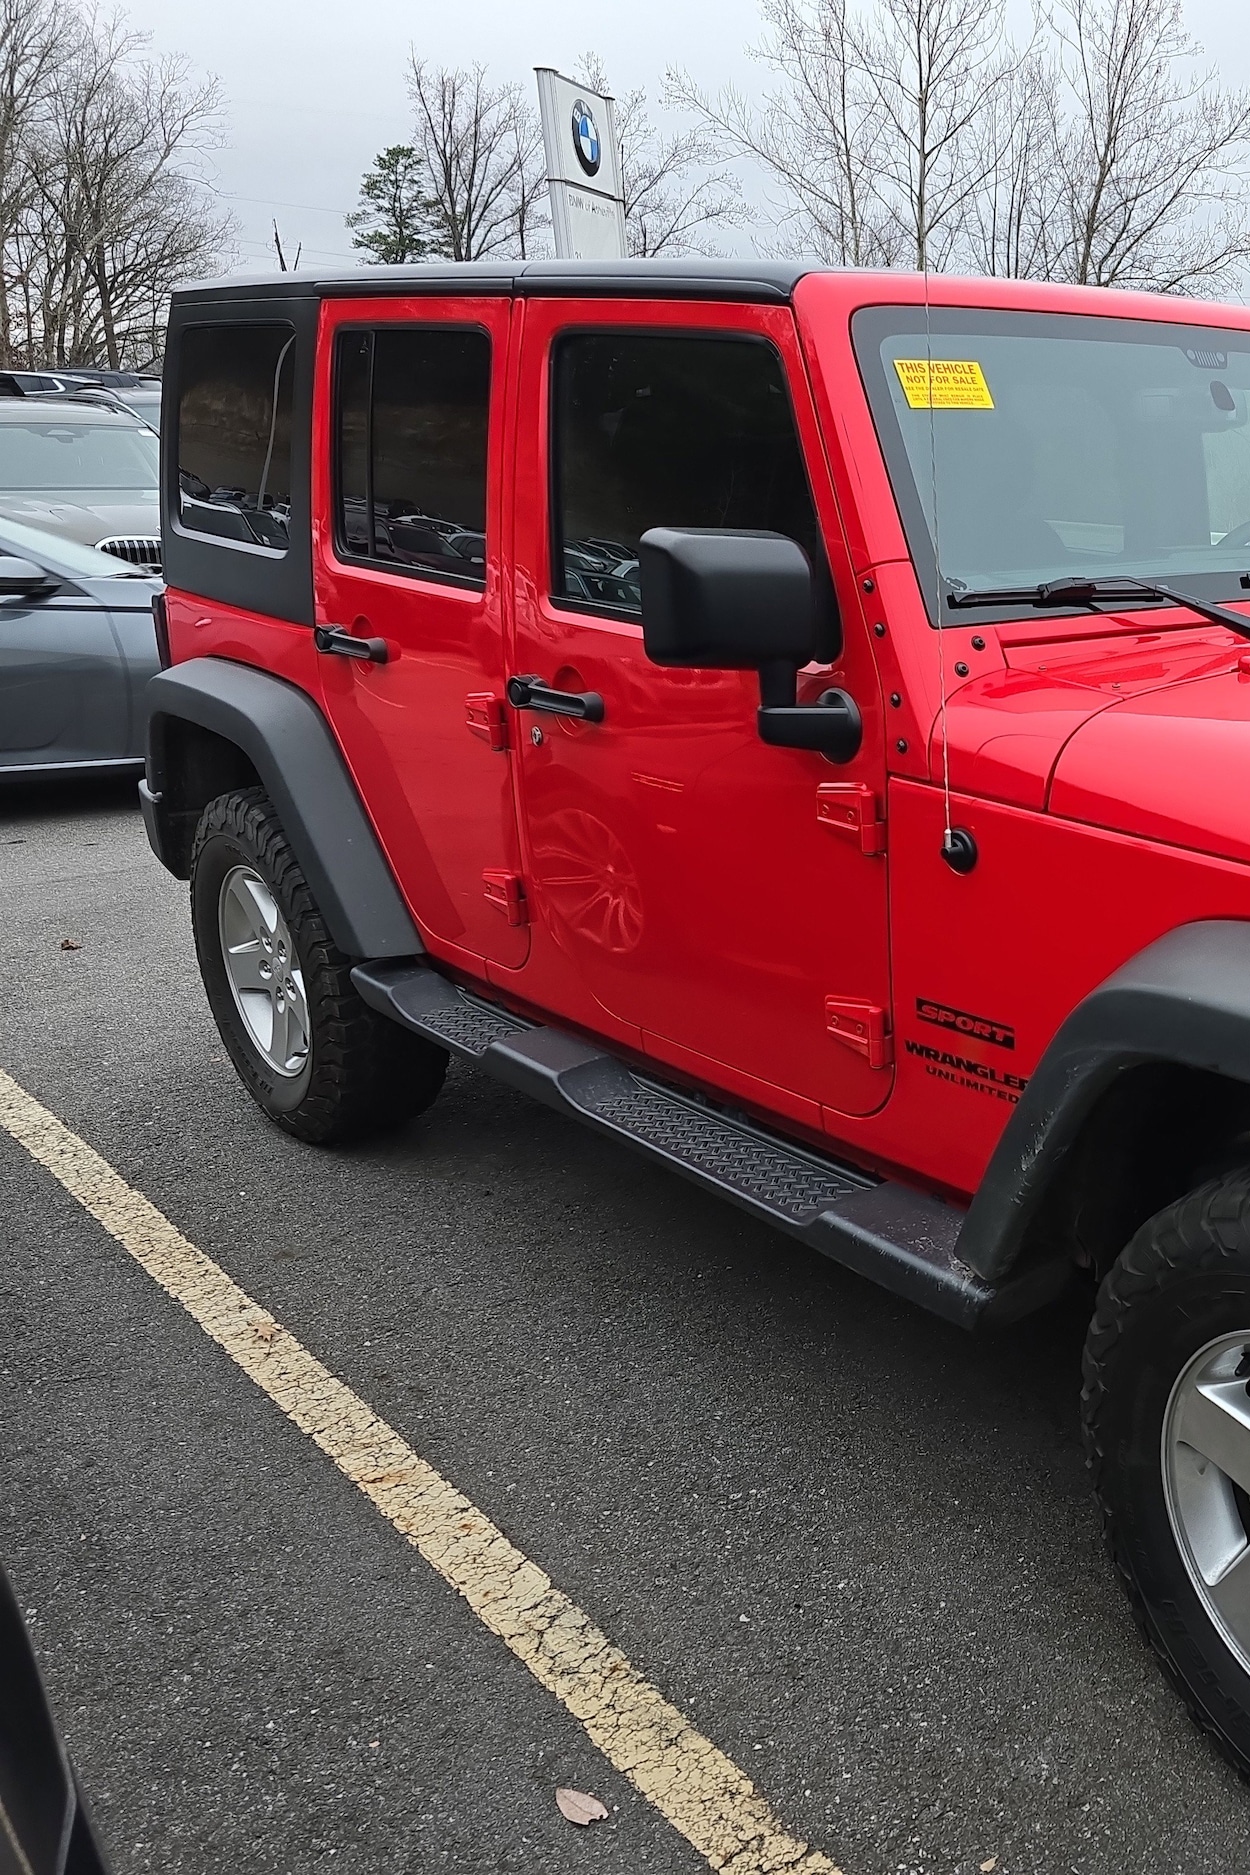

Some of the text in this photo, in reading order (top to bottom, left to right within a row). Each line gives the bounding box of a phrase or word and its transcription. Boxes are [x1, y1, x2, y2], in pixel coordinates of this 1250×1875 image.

[897, 362, 977, 375] THIS VEHICLE
[906, 375, 978, 385] NOT FOR SALE
[917, 1003, 1014, 1042] SPORT
[925, 1065, 1020, 1105] UNLIMITED
